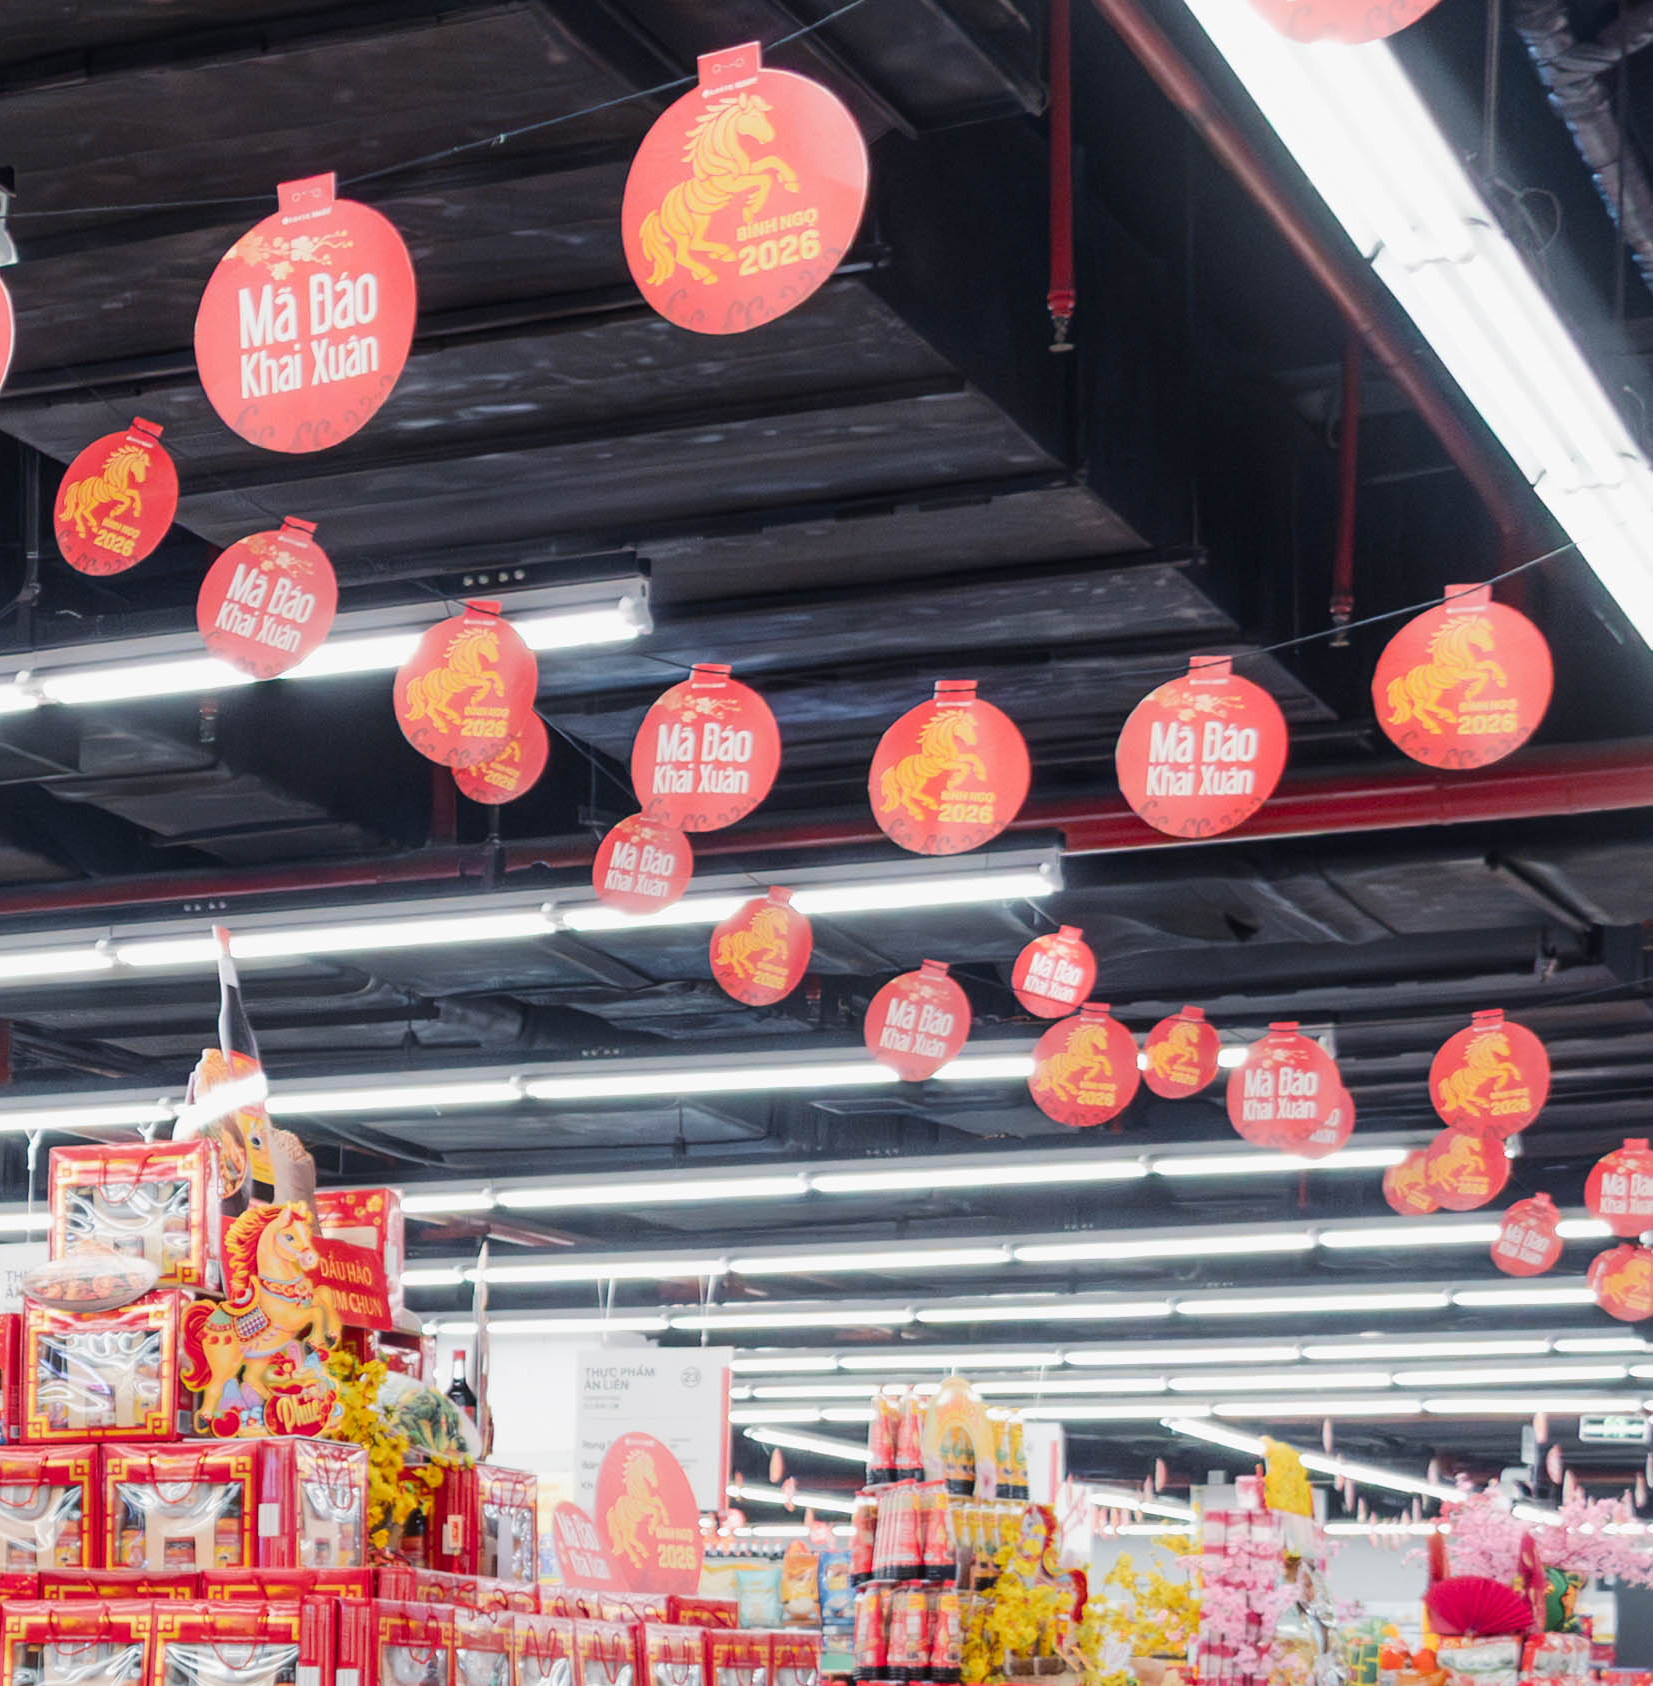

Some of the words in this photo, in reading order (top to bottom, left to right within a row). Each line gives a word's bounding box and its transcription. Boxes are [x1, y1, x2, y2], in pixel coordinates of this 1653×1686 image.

[738, 230, 820, 275] 2026
[239, 285, 297, 348] Mã
[310, 272, 377, 335] Đáo
[241, 350, 301, 398] Khai
[311, 335, 378, 385] Xuân
[227, 564, 268, 608] Mã
[268, 578, 315, 623] Đáo
[215, 601, 255, 638] Khai
[255, 616, 301, 653] Xuân
[657, 724, 694, 762] Mã
[701, 723, 752, 762] Đáo
[1150, 722, 1194, 763] Mã
[1203, 722, 1257, 762] Đáo
[1458, 713, 1517, 734] 2026
[653, 764, 693, 793] Khai
[698, 764, 749, 793] Xuân
[1147, 765, 1194, 795] Khai
[1199, 765, 1253, 795] Xuân
[939, 804, 993, 823] 2026
